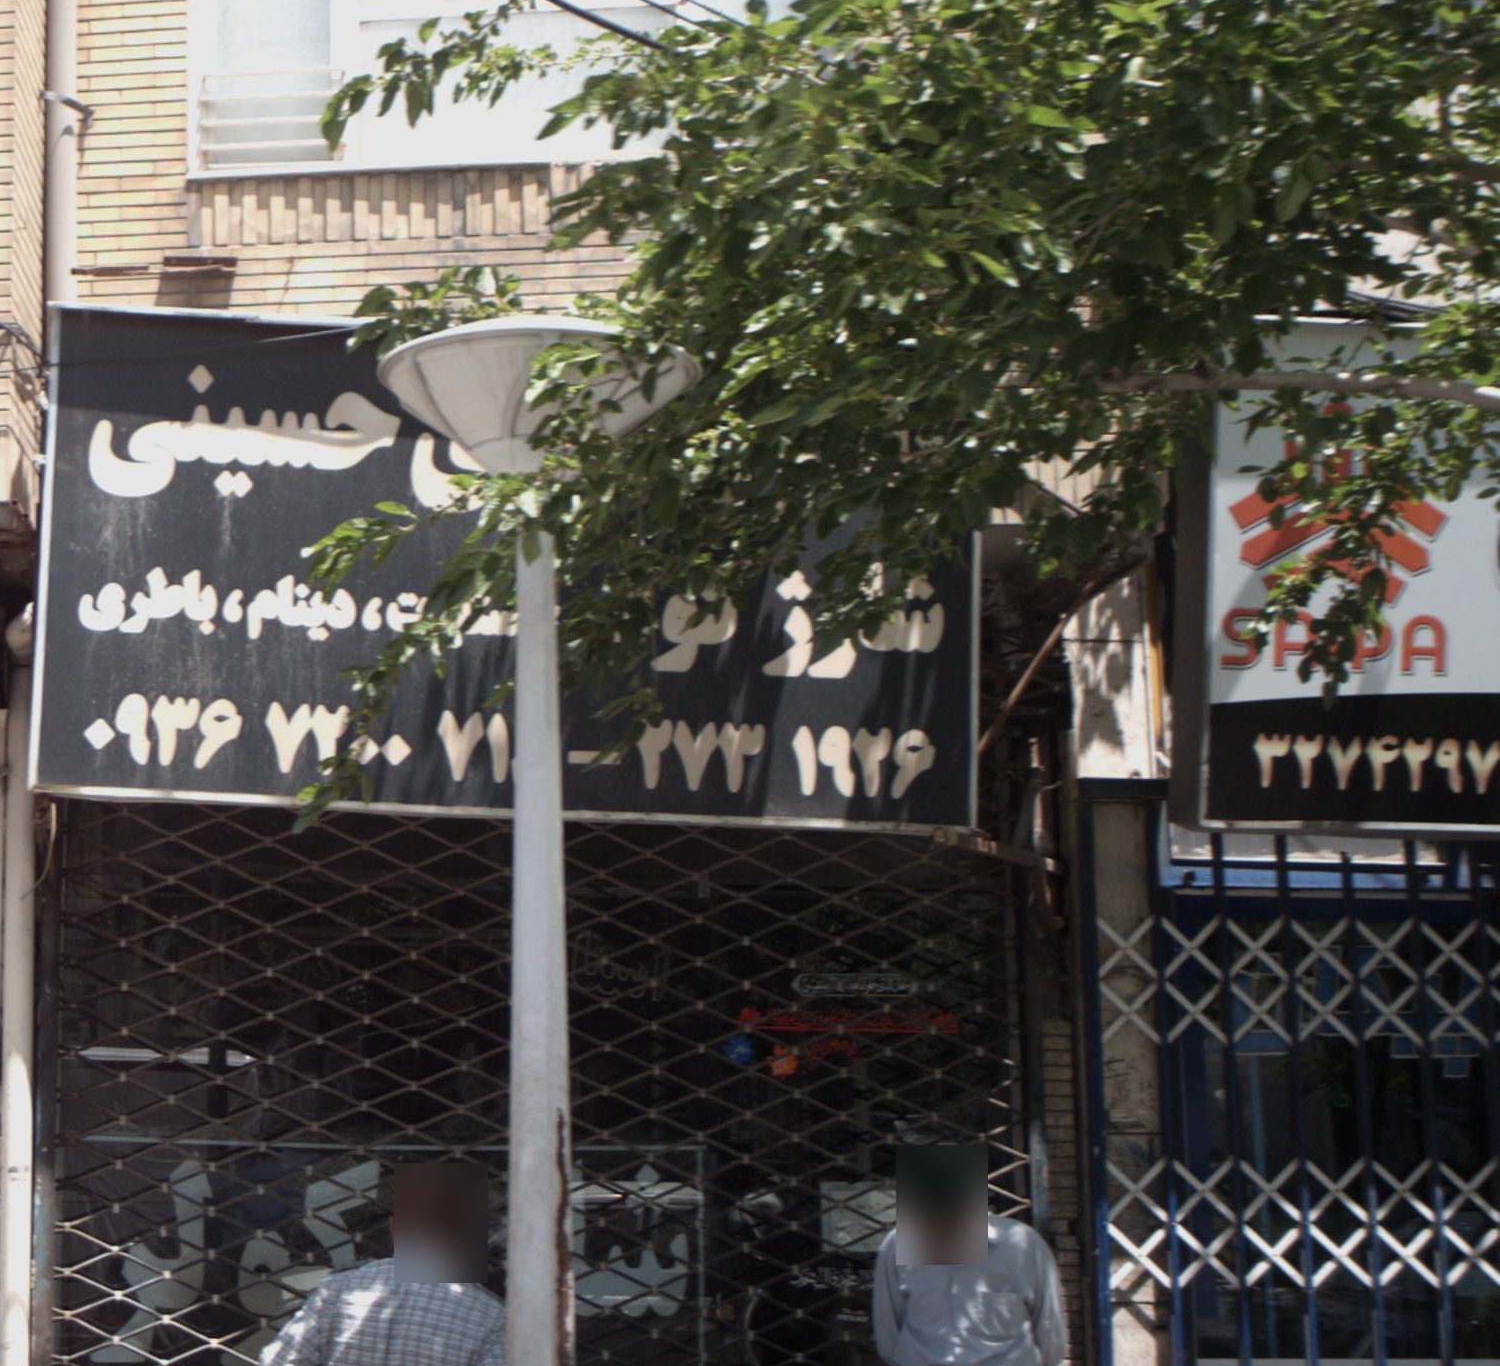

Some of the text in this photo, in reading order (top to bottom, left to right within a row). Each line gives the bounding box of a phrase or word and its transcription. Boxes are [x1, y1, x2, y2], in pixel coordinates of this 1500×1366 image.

[88, 364, 401, 497] حسینی
[78, 566, 218, 635] باطری
[1220, 608, 1448, 675] SAPA
[83, 692, 243, 770] ۰۹۳۶
